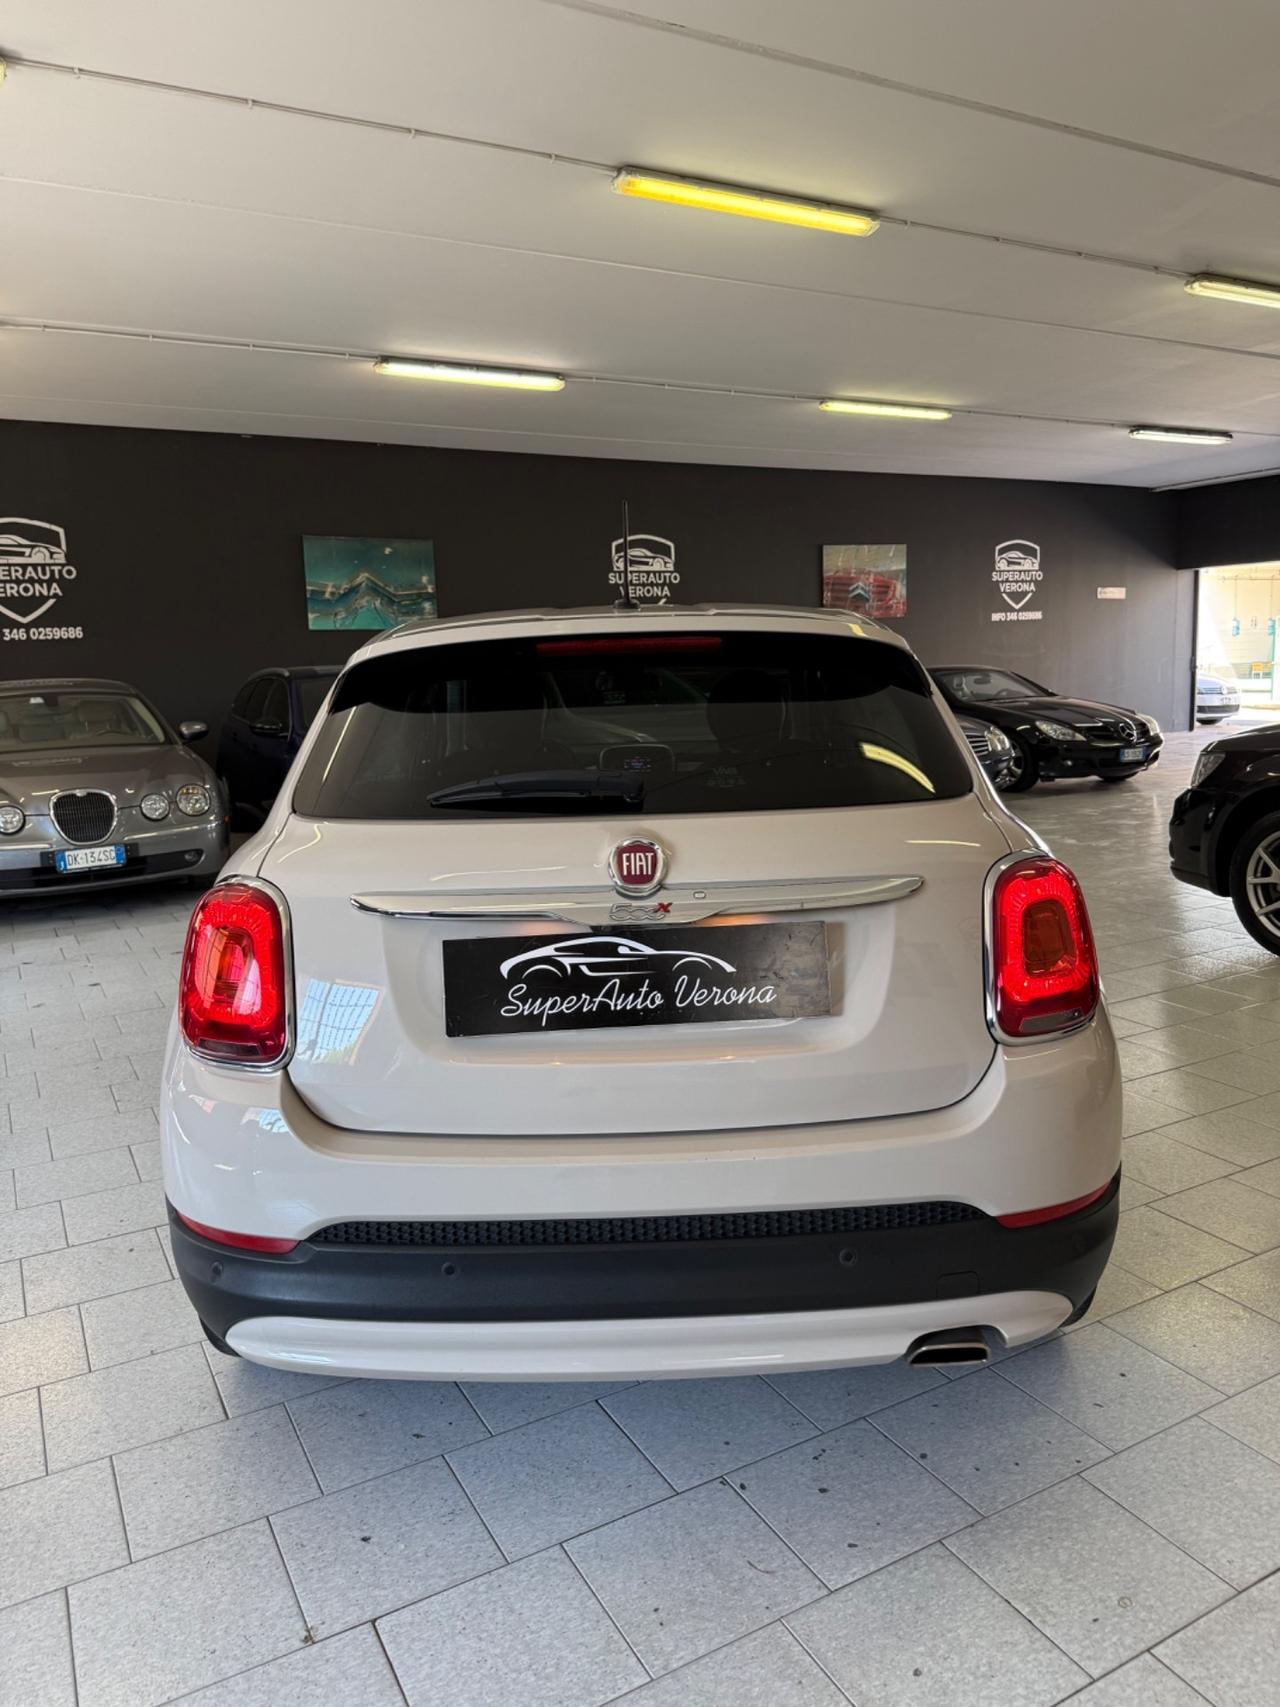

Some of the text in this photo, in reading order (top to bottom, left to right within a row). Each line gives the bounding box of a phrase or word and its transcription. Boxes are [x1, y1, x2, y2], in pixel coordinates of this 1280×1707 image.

[991, 571, 1043, 581] SUPERAUTO
[999, 582, 1036, 592] VERONA
[2, 626, 84, 641] 346 0259686
[622, 852, 654, 876] FIAT
[500, 975, 777, 1027] SuperAuto Verona
